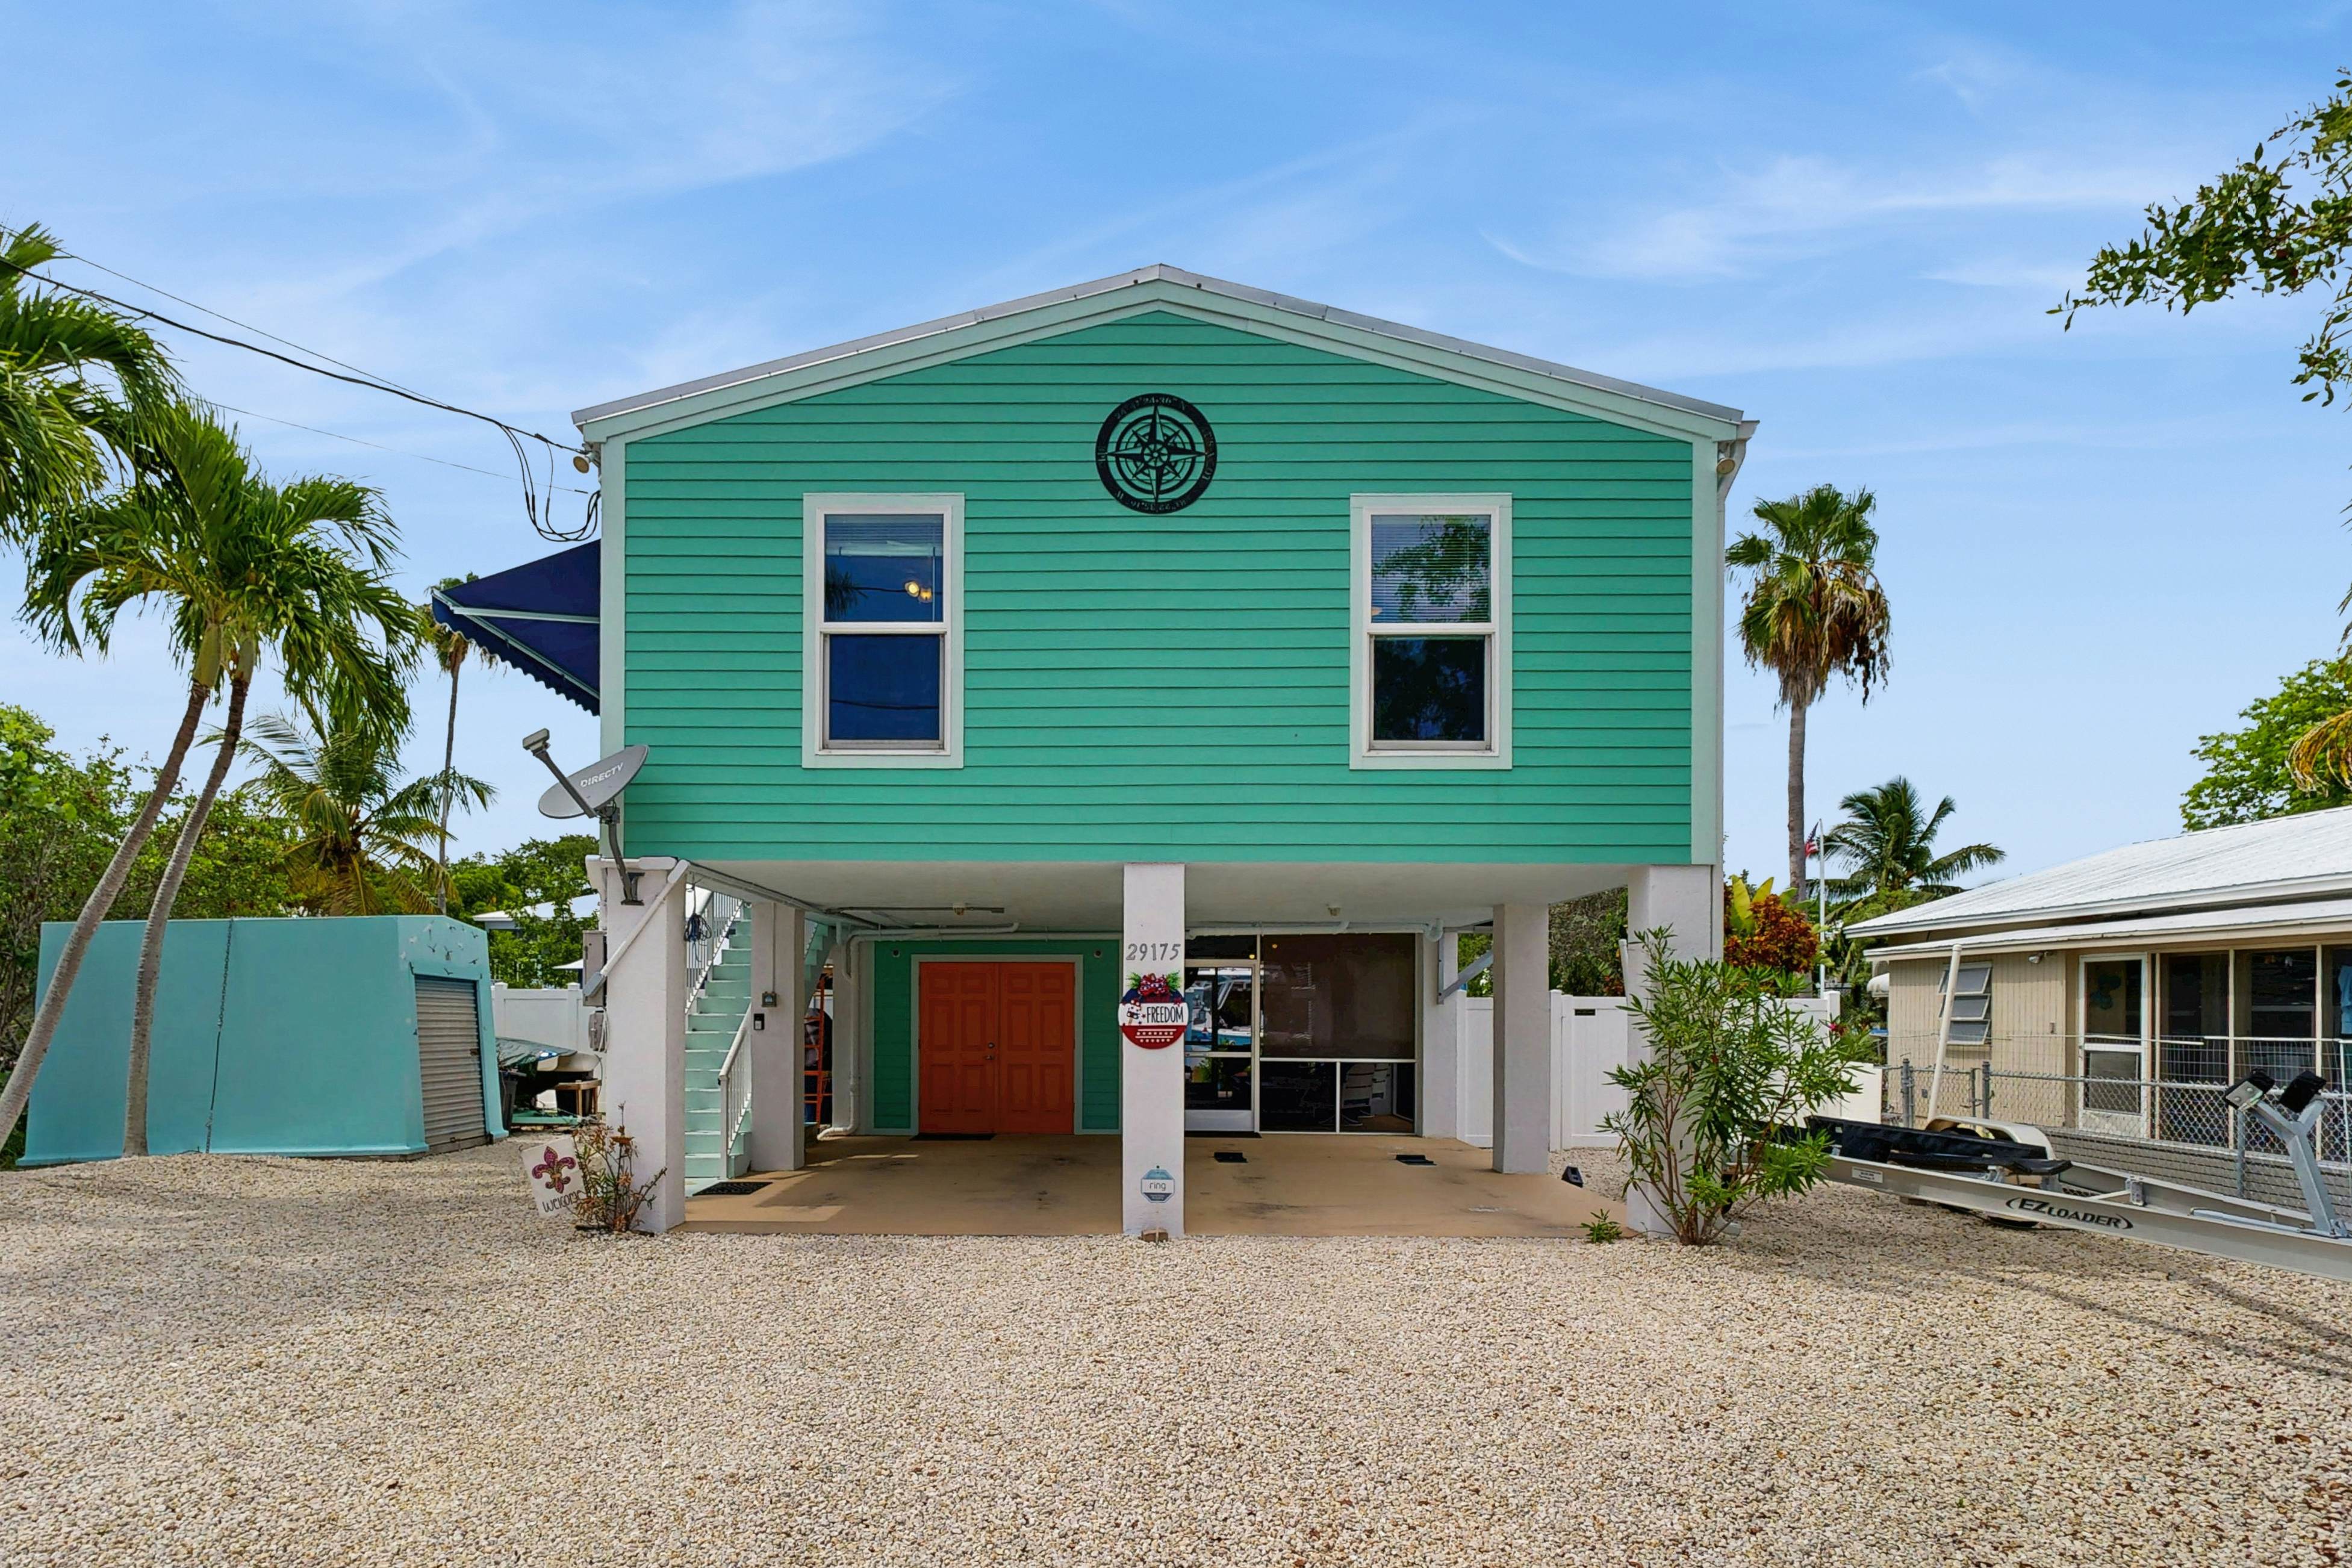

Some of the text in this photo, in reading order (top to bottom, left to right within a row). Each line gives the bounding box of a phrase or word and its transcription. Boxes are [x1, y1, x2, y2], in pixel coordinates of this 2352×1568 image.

[580, 762, 624, 788] DIRECTV
[1126, 943, 1181, 960] 29175
[1146, 1006, 1184, 1023] FREEDOM
[1149, 1182, 1166, 1191] ring
